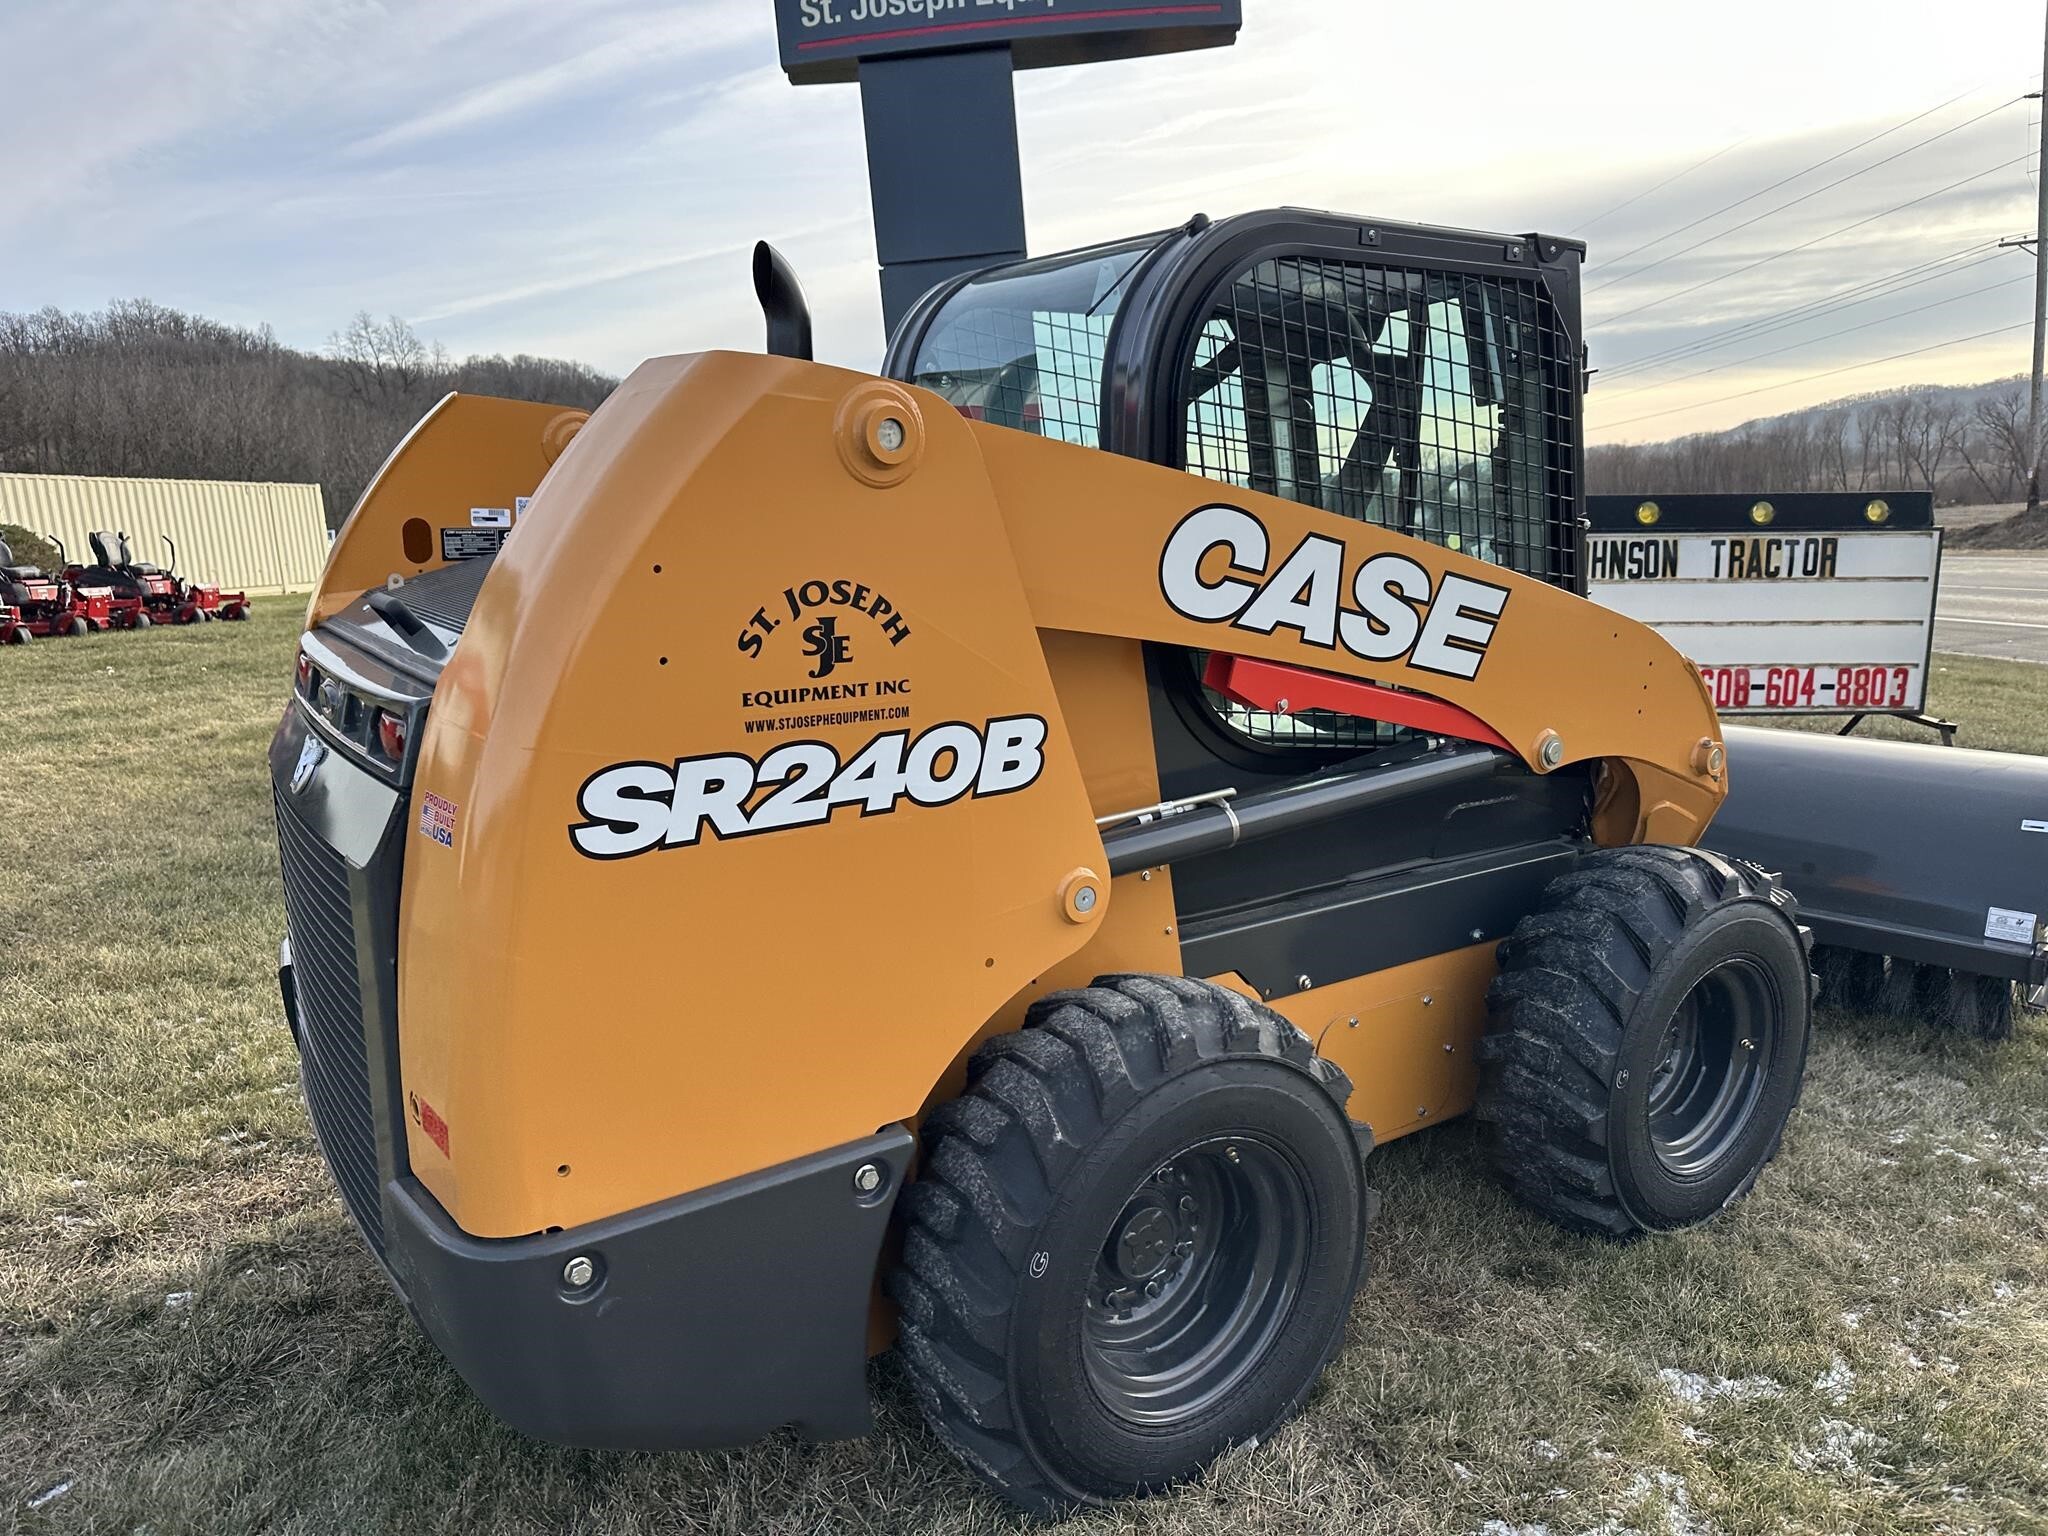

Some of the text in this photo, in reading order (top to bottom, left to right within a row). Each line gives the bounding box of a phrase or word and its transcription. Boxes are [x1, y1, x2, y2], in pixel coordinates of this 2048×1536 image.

[800, 0, 841, 27] St.
[850, 0, 965, 20] Josep
[1586, 537, 1839, 579] HNSON TRACTOR
[1159, 503, 1511, 682] CASE
[738, 580, 911, 659] ST. JOSEPH
[742, 679, 911, 708] EQUIPMENT INC
[744, 706, 910, 733] WWW.STJOSEPHEQUIPMENT.COM
[568, 713, 1047, 860] SR240B
[425, 791, 458, 815] PROUDLY
[434, 811, 455, 829] BUILT
[432, 824, 452, 848] USA
